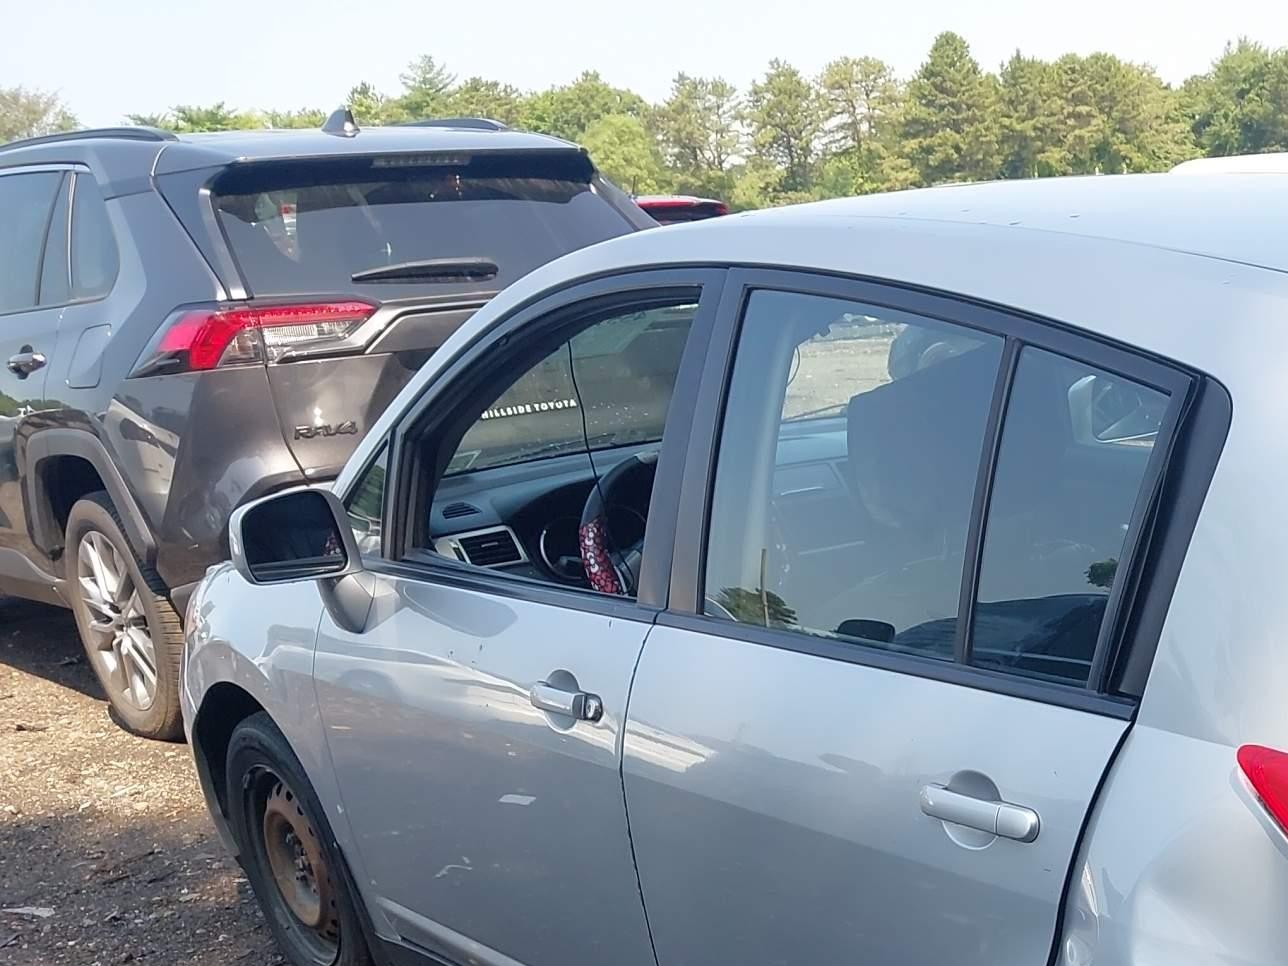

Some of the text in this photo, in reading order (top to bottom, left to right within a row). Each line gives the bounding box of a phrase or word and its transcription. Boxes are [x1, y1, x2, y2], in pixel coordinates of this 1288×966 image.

[481, 399, 577, 420] HILLSIDE TOYOTA
[294, 420, 359, 440] RAV4
